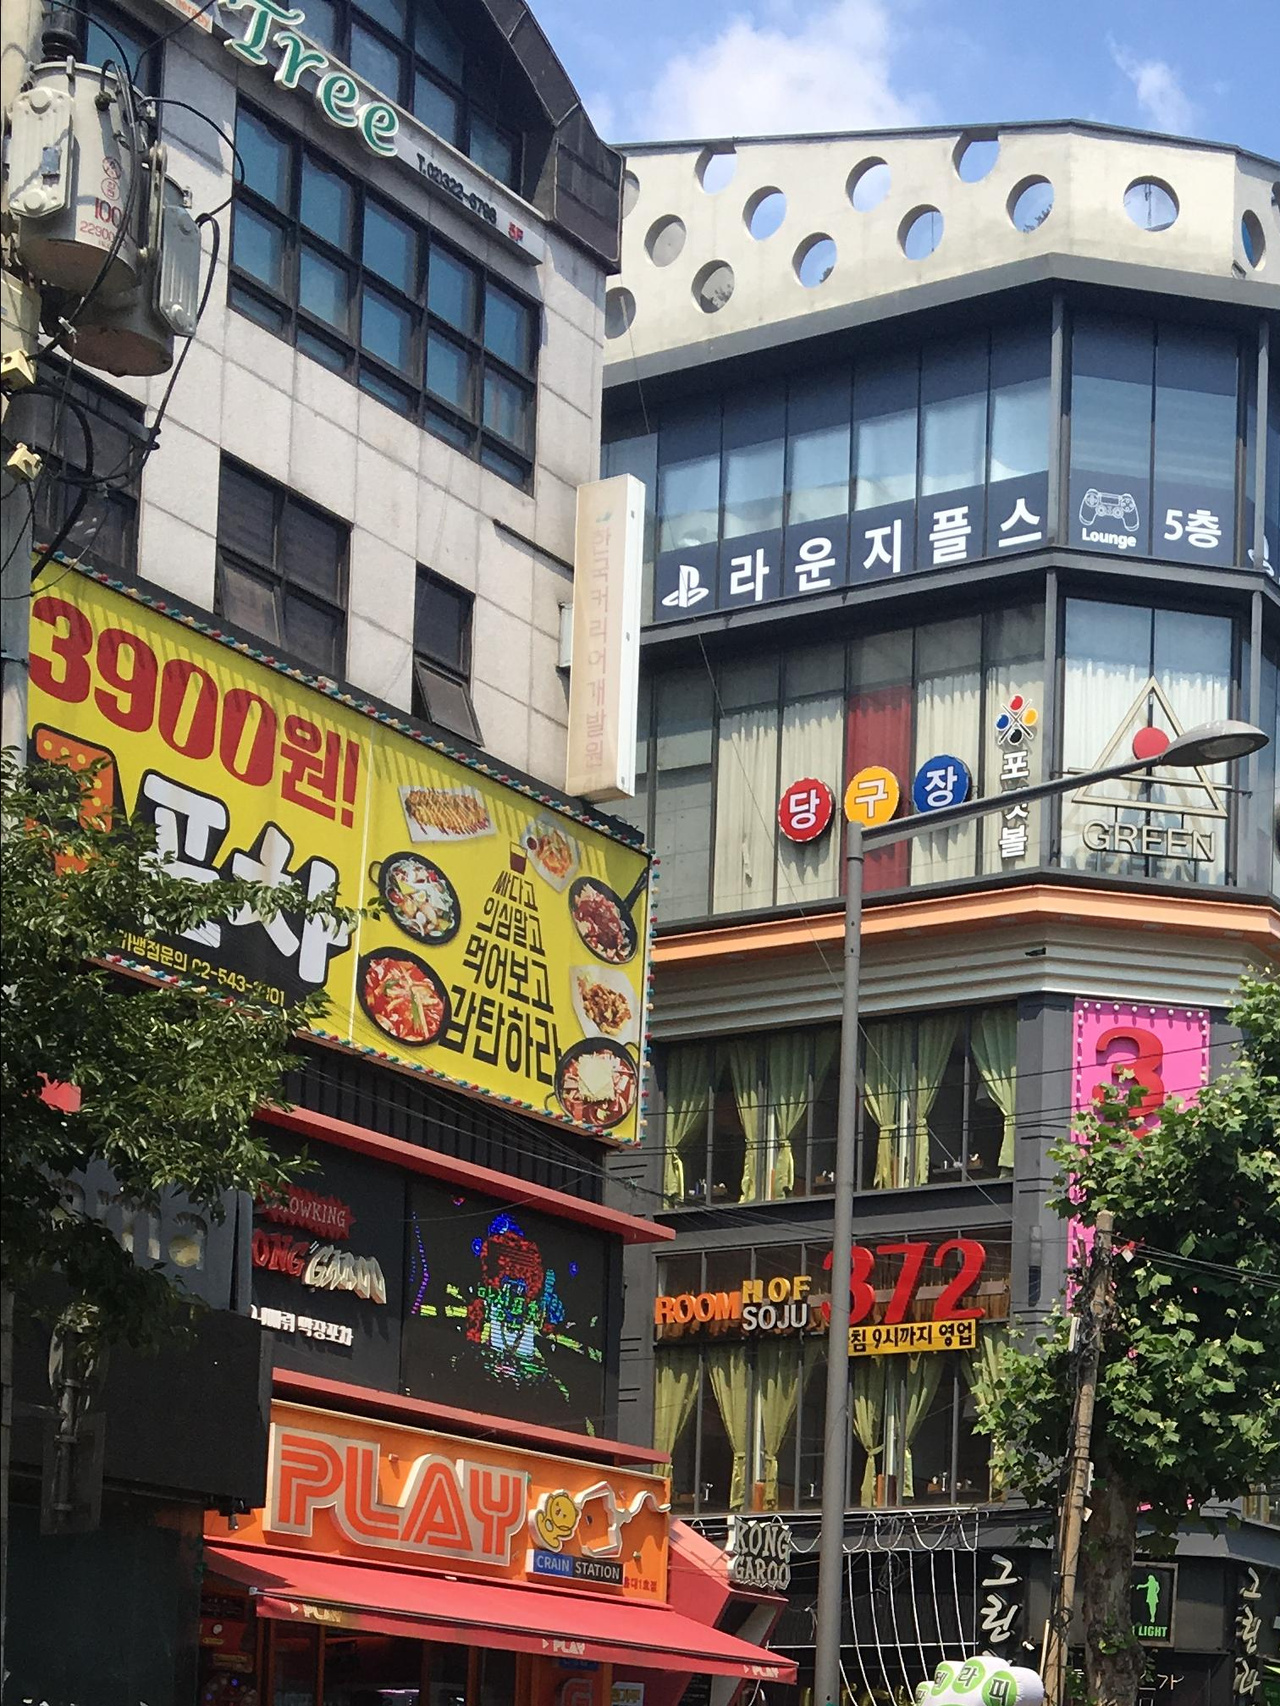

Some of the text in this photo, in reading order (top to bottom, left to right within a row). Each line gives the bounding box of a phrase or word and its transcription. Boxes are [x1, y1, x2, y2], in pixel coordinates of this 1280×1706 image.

[218, 0, 399, 157] Tree
[1082, 527, 1137, 549] Lounge
[1164, 509, 1222, 548] 5층
[28, 596, 359, 828] 3900원!
[1083, 819, 1217, 862] GREEN
[492, 870, 538, 912] 싸다고
[476, 897, 545, 957] 의심말고
[463, 934, 554, 1014] 먹어보고
[438, 984, 562, 1086] 감탄하라
[251, 1228, 306, 1277] ONG
[742, 1275, 812, 1305] HOF
[821, 1238, 986, 1326] 372
[654, 1291, 741, 1325] ROOM
[742, 1303, 810, 1332] SOJU
[850, 1321, 973, 1353] 침 9시까지 영업
[276, 1432, 523, 1558] PLAY
[734, 1516, 793, 1565] KONG
[536, 1555, 620, 1580] CRAIN STATION
[733, 1555, 792, 1590] GAROO
[981, 1554, 1022, 1646] 그린
[553, 1639, 586, 1655] PLAY
[1138, 1625, 1168, 1638] LIGHT
[752, 1665, 780, 1678] PLAY
